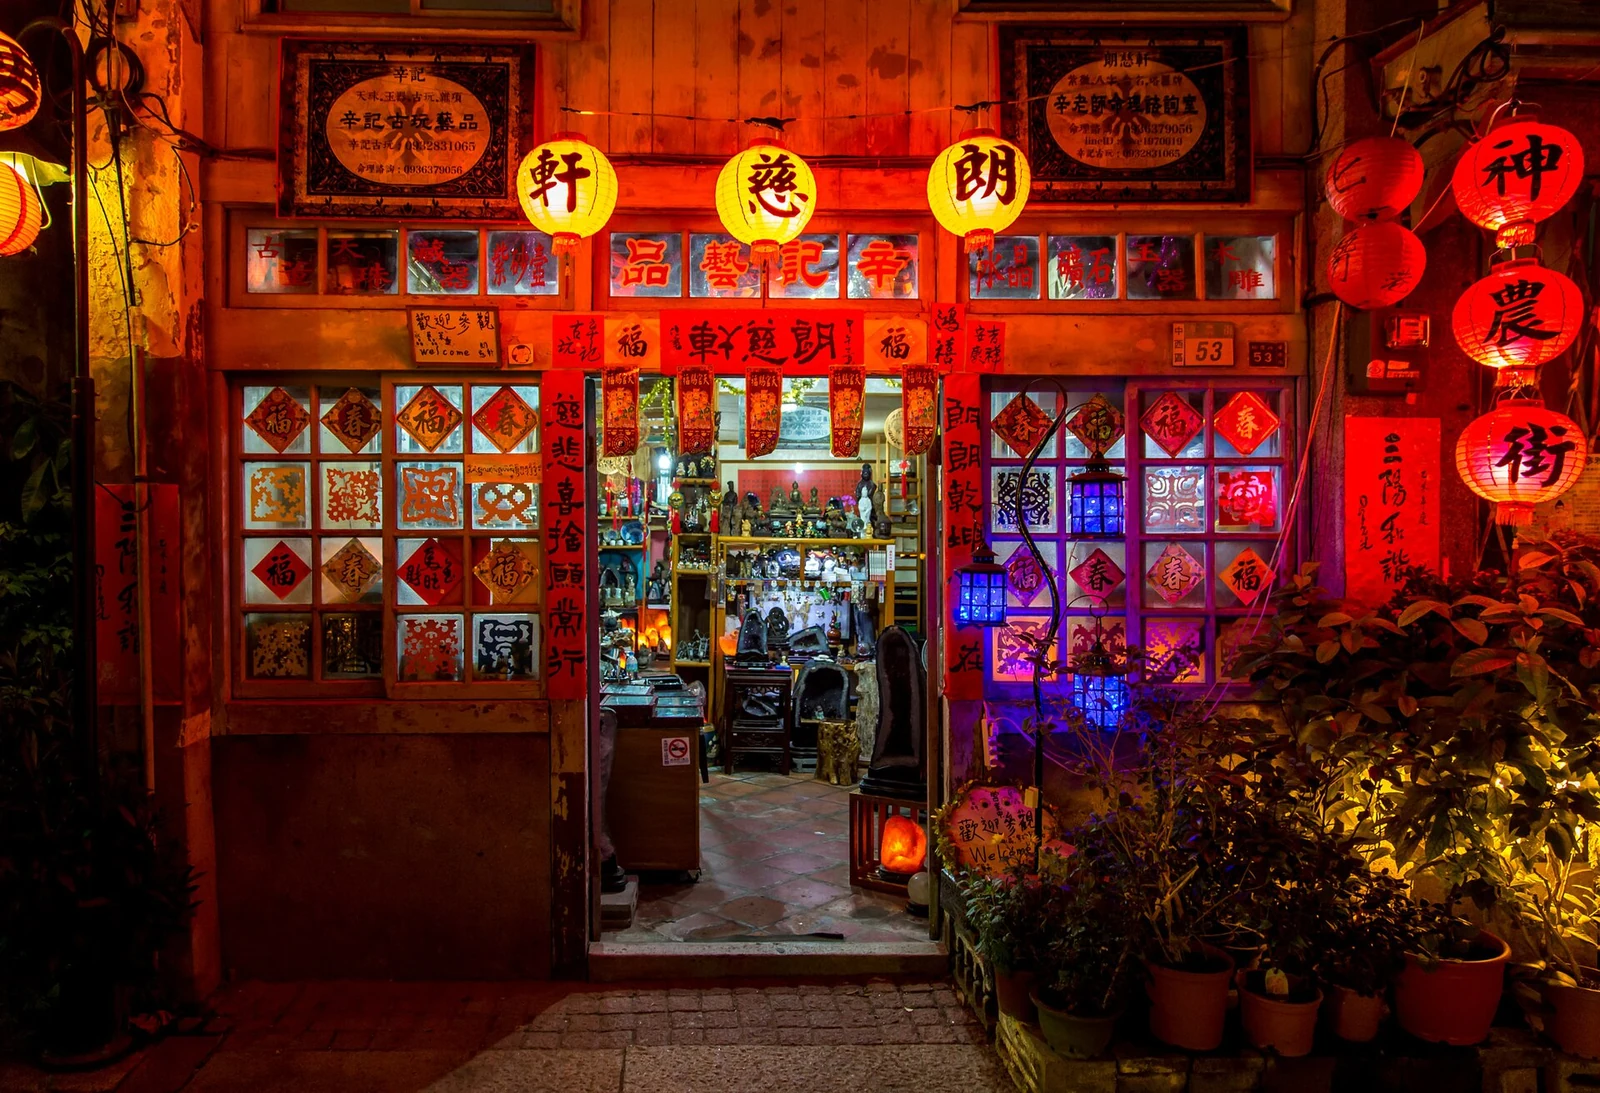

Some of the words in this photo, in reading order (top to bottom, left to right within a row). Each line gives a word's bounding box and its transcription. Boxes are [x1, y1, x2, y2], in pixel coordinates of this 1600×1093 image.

[393, 67, 426, 83] 辛記
[339, 110, 478, 131] 辛記古玩藝品
[529, 148, 591, 213] 軒
[953, 145, 1016, 205] 朗
[1481, 134, 1563, 203] 神
[748, 155, 808, 217] 慈
[976, 244, 1033, 296] 水晶
[1057, 244, 1114, 291] 礦石
[1128, 242, 1187, 293] 玉器
[1210, 242, 1265, 293] 木雕
[416, 311, 494, 335] 歡迎參觀
[1482, 279, 1561, 345] 農
[619, 325, 649, 360] 福
[880, 325, 911, 360] 福
[1195, 341, 1223, 361] 53
[1253, 352, 1272, 362] 53
[266, 405, 292, 434] 福
[343, 405, 371, 437] 春
[413, 400, 445, 434] 福
[494, 404, 522, 437] 春
[1011, 410, 1038, 440] 春
[1086, 409, 1111, 441] 福
[1157, 406, 1187, 437] 福
[1236, 406, 1259, 438] 春
[1495, 422, 1575, 489] 街
[266, 555, 296, 585] 福
[341, 553, 370, 587] 春
[491, 556, 519, 586] 福
[1012, 558, 1039, 589] 福
[1085, 558, 1114, 589] 春
[1162, 556, 1191, 591] 春
[1231, 559, 1260, 591] 福
[958, 810, 1035, 842] 歡迎參觀
